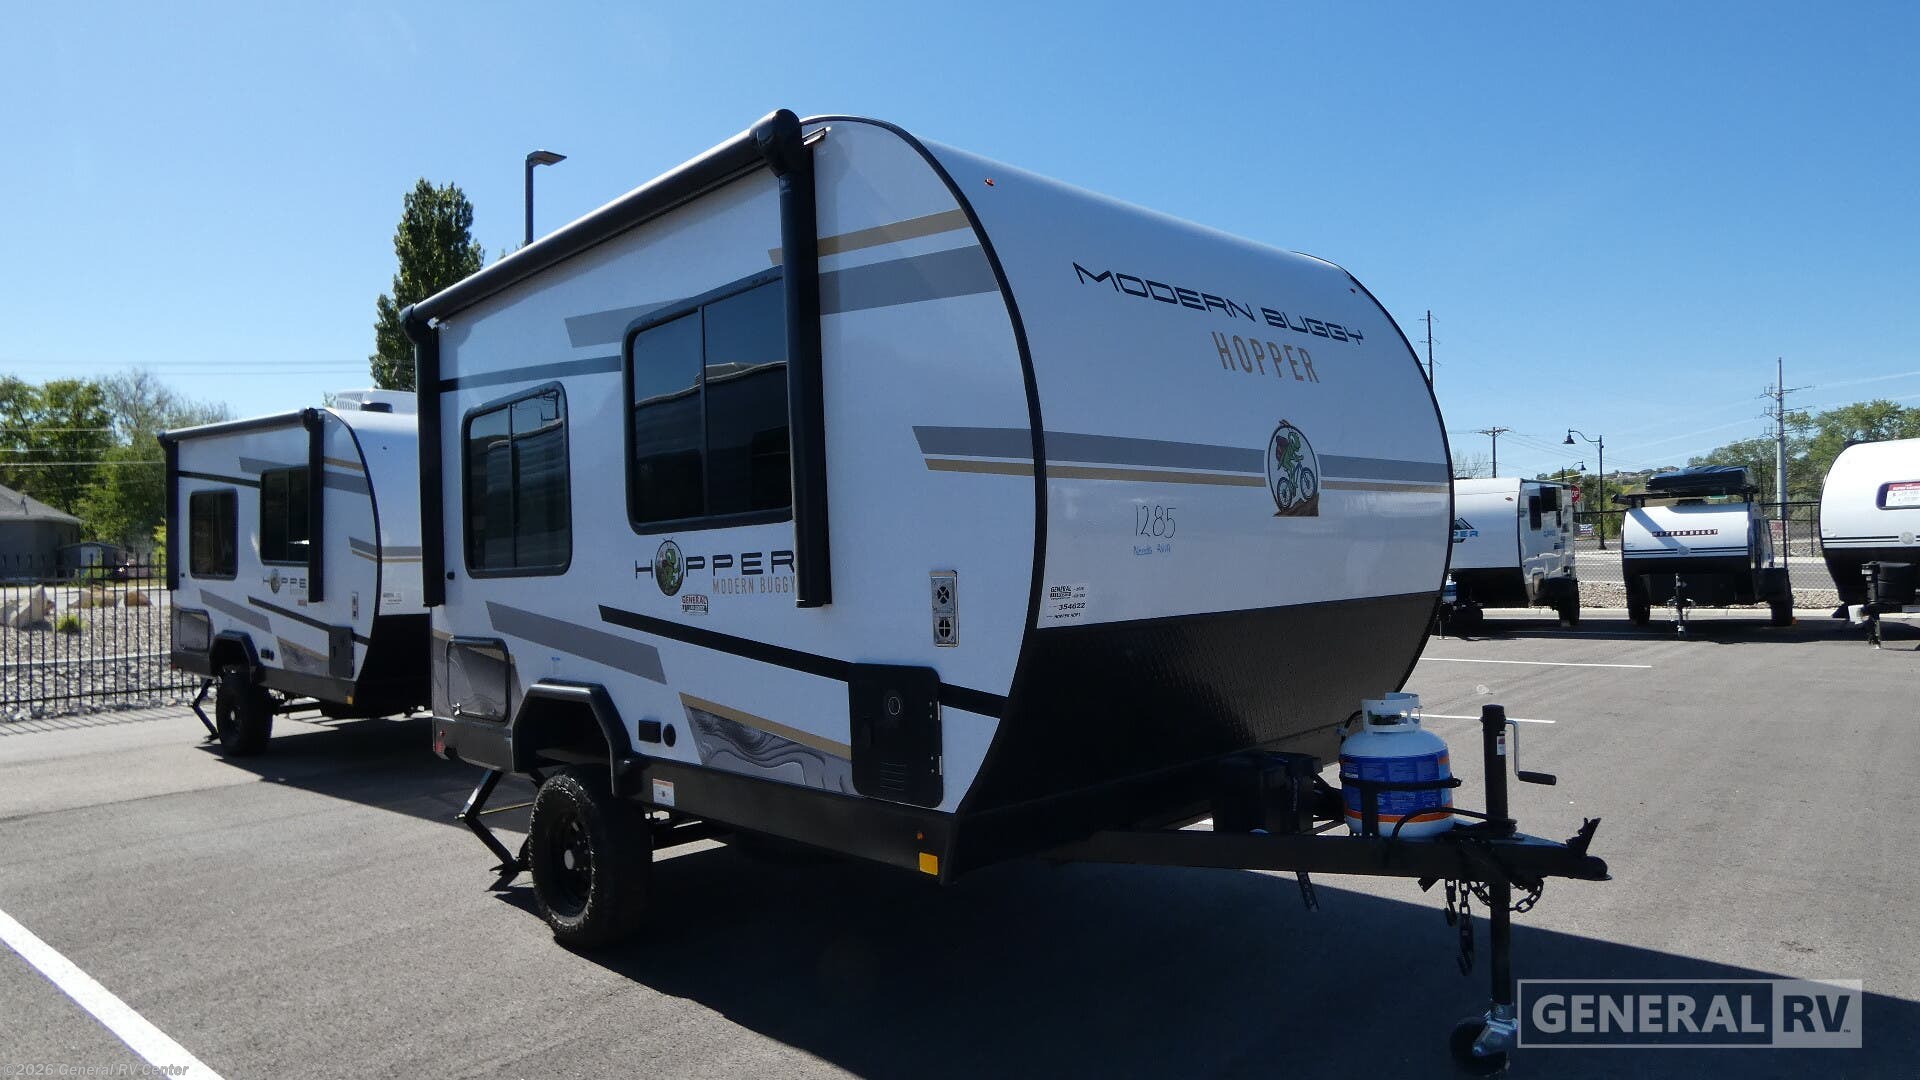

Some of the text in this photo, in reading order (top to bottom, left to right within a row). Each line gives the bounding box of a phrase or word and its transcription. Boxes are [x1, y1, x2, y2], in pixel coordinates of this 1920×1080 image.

[1073, 261, 1364, 345] MODERN BUGGY
[1211, 331, 1320, 384] HOPPER
[1135, 504, 1177, 539] 1285
[635, 541, 795, 595] HOPPER
[712, 575, 796, 594] MODERN BUGGY
[681, 595, 707, 604] GENERAL
